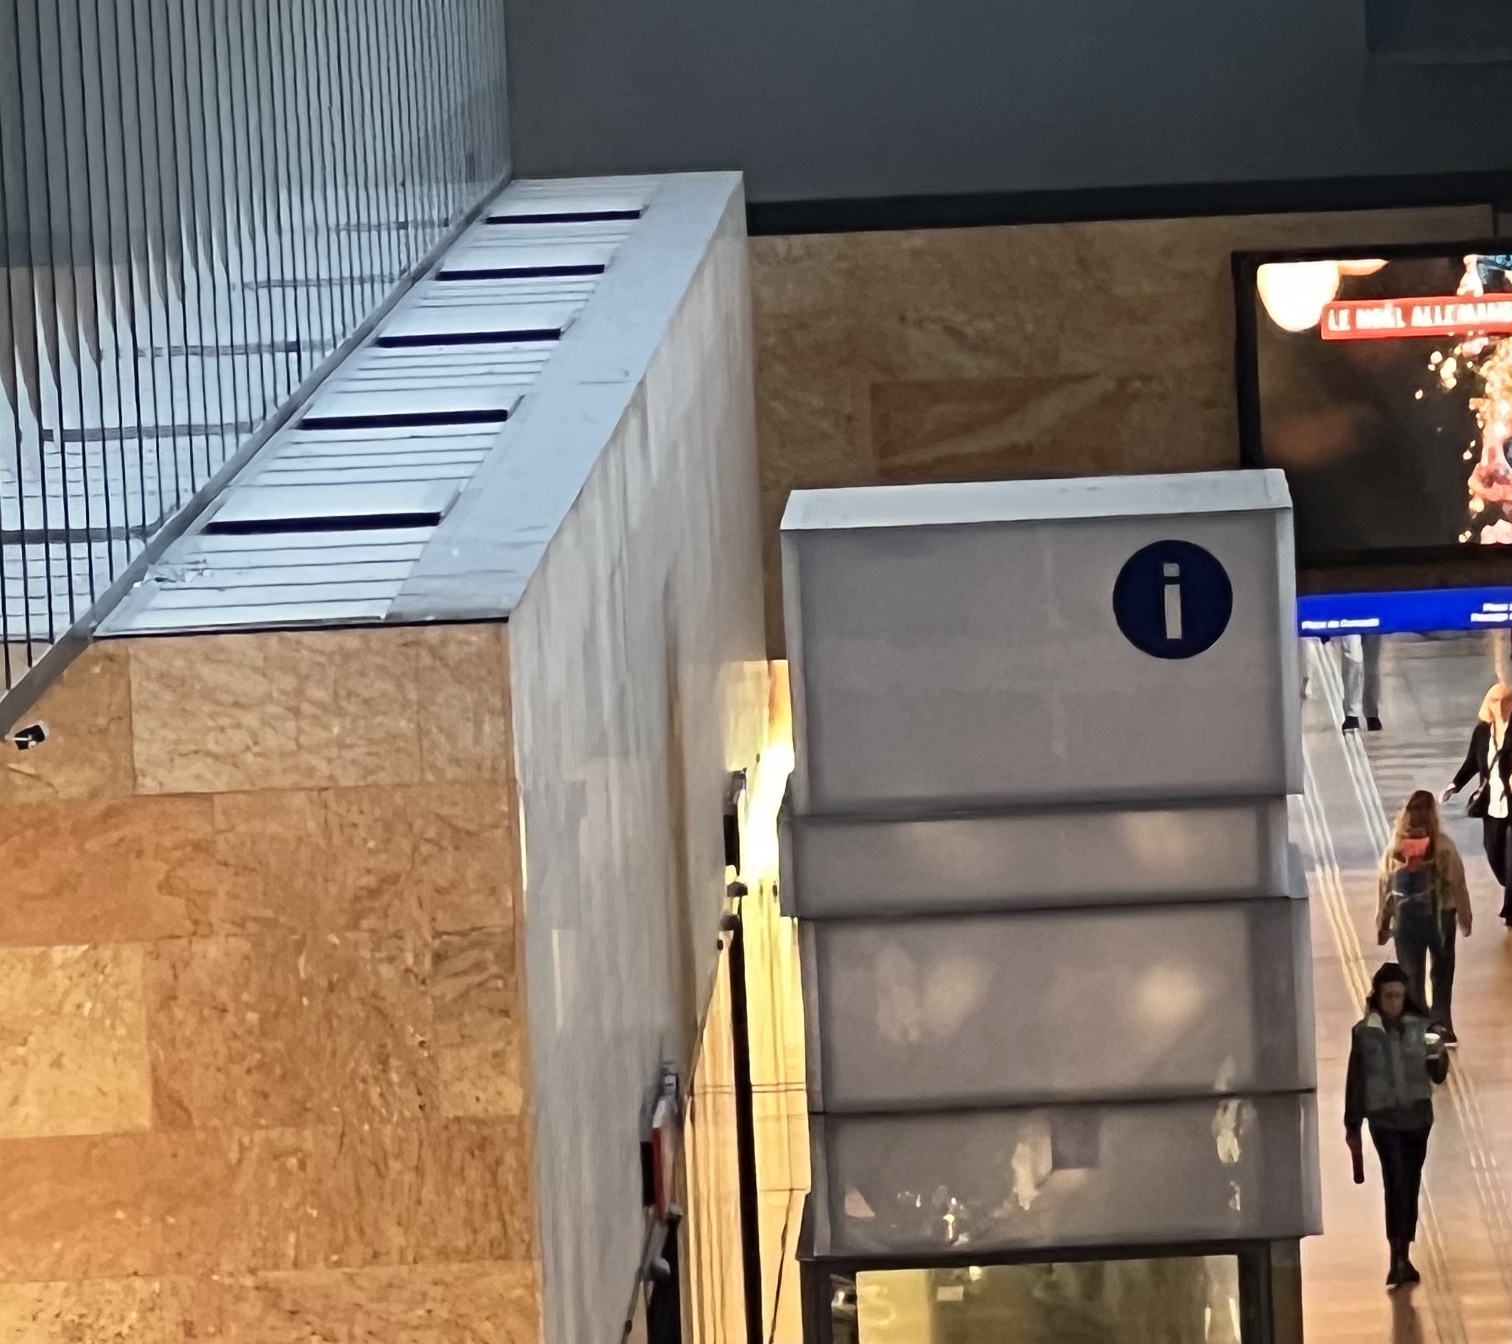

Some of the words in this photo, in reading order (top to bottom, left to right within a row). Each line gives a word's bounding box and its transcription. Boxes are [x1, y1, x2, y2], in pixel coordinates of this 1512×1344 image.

[1327, 308, 1352, 331] LE
[1355, 302, 1406, 330] NOËL
[1163, 562, 1182, 640] i
